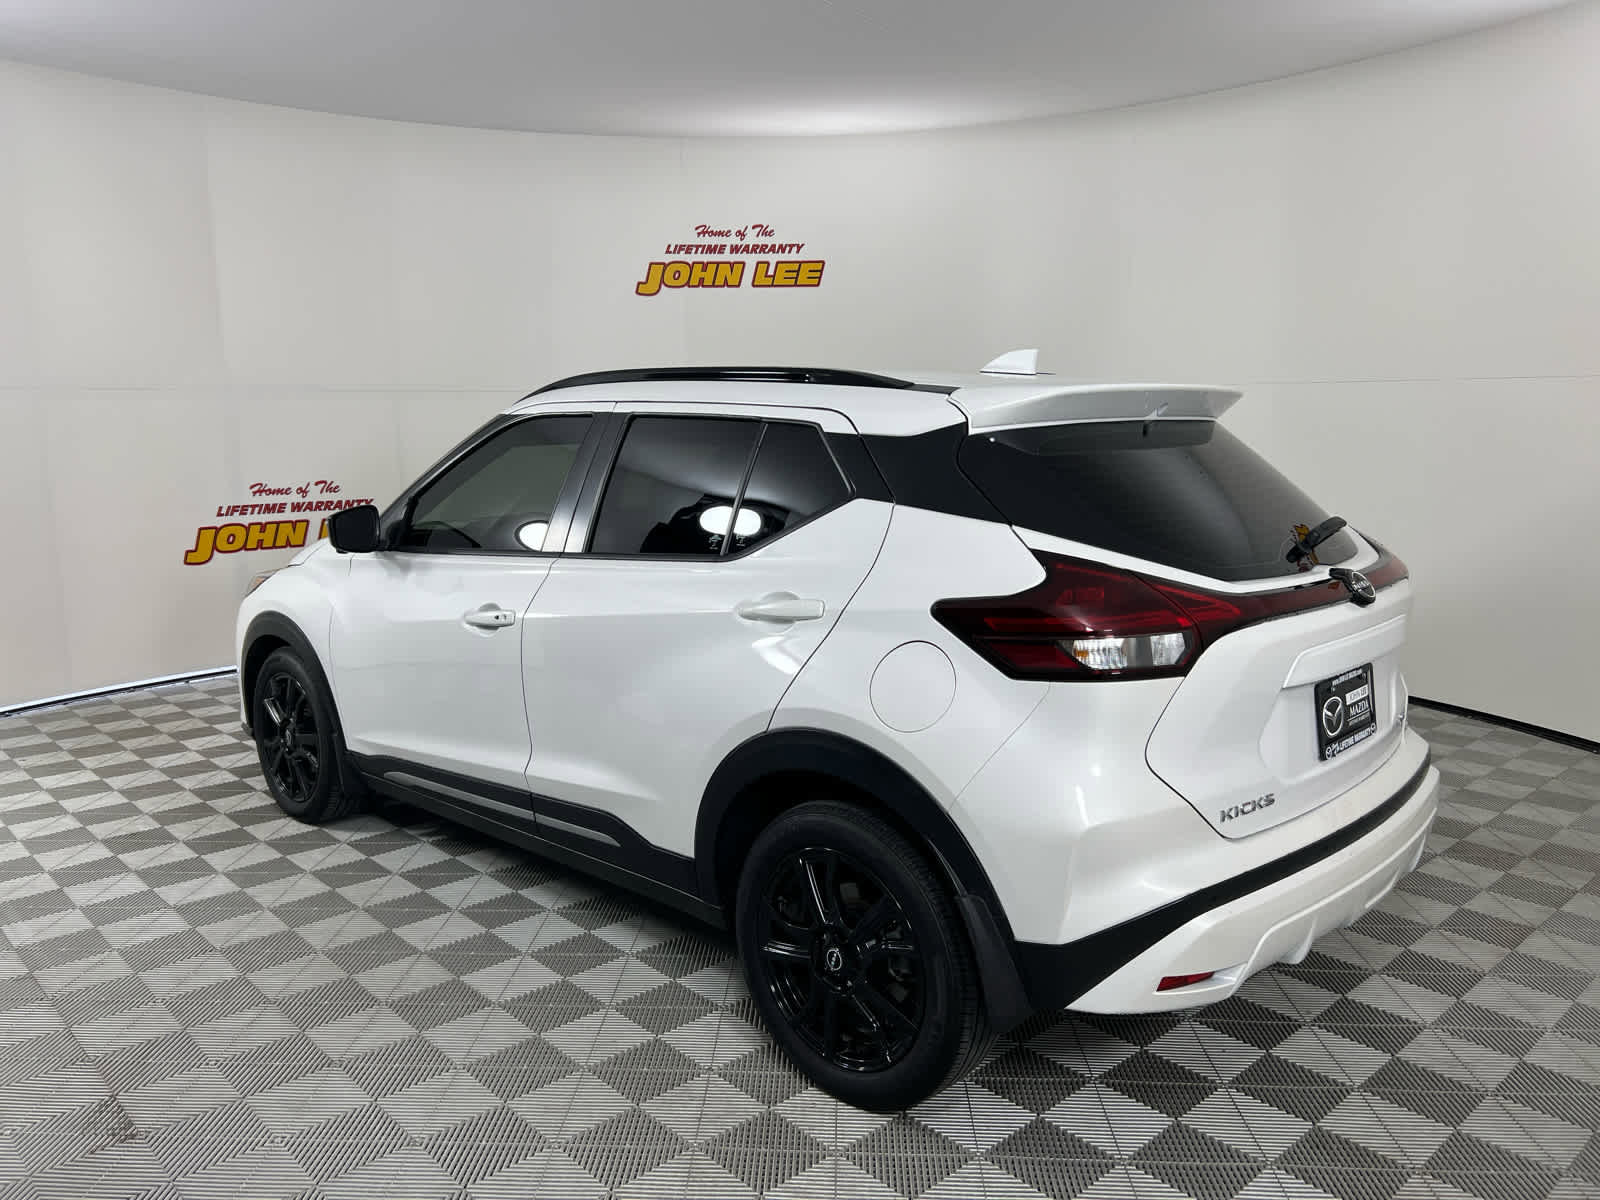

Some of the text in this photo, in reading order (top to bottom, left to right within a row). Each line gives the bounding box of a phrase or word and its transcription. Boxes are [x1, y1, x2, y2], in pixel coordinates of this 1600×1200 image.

[694, 223, 775, 241] Home of The
[665, 243, 805, 255] LIFETIME WARRANTY
[635, 260, 825, 296] JOHN LEE
[249, 480, 341, 498] Home of The
[216, 502, 287, 517] LIFETIME
[184, 519, 309, 565] JOHN
[1349, 699, 1369, 716] MAZDA
[1220, 793, 1275, 822] KICKS
